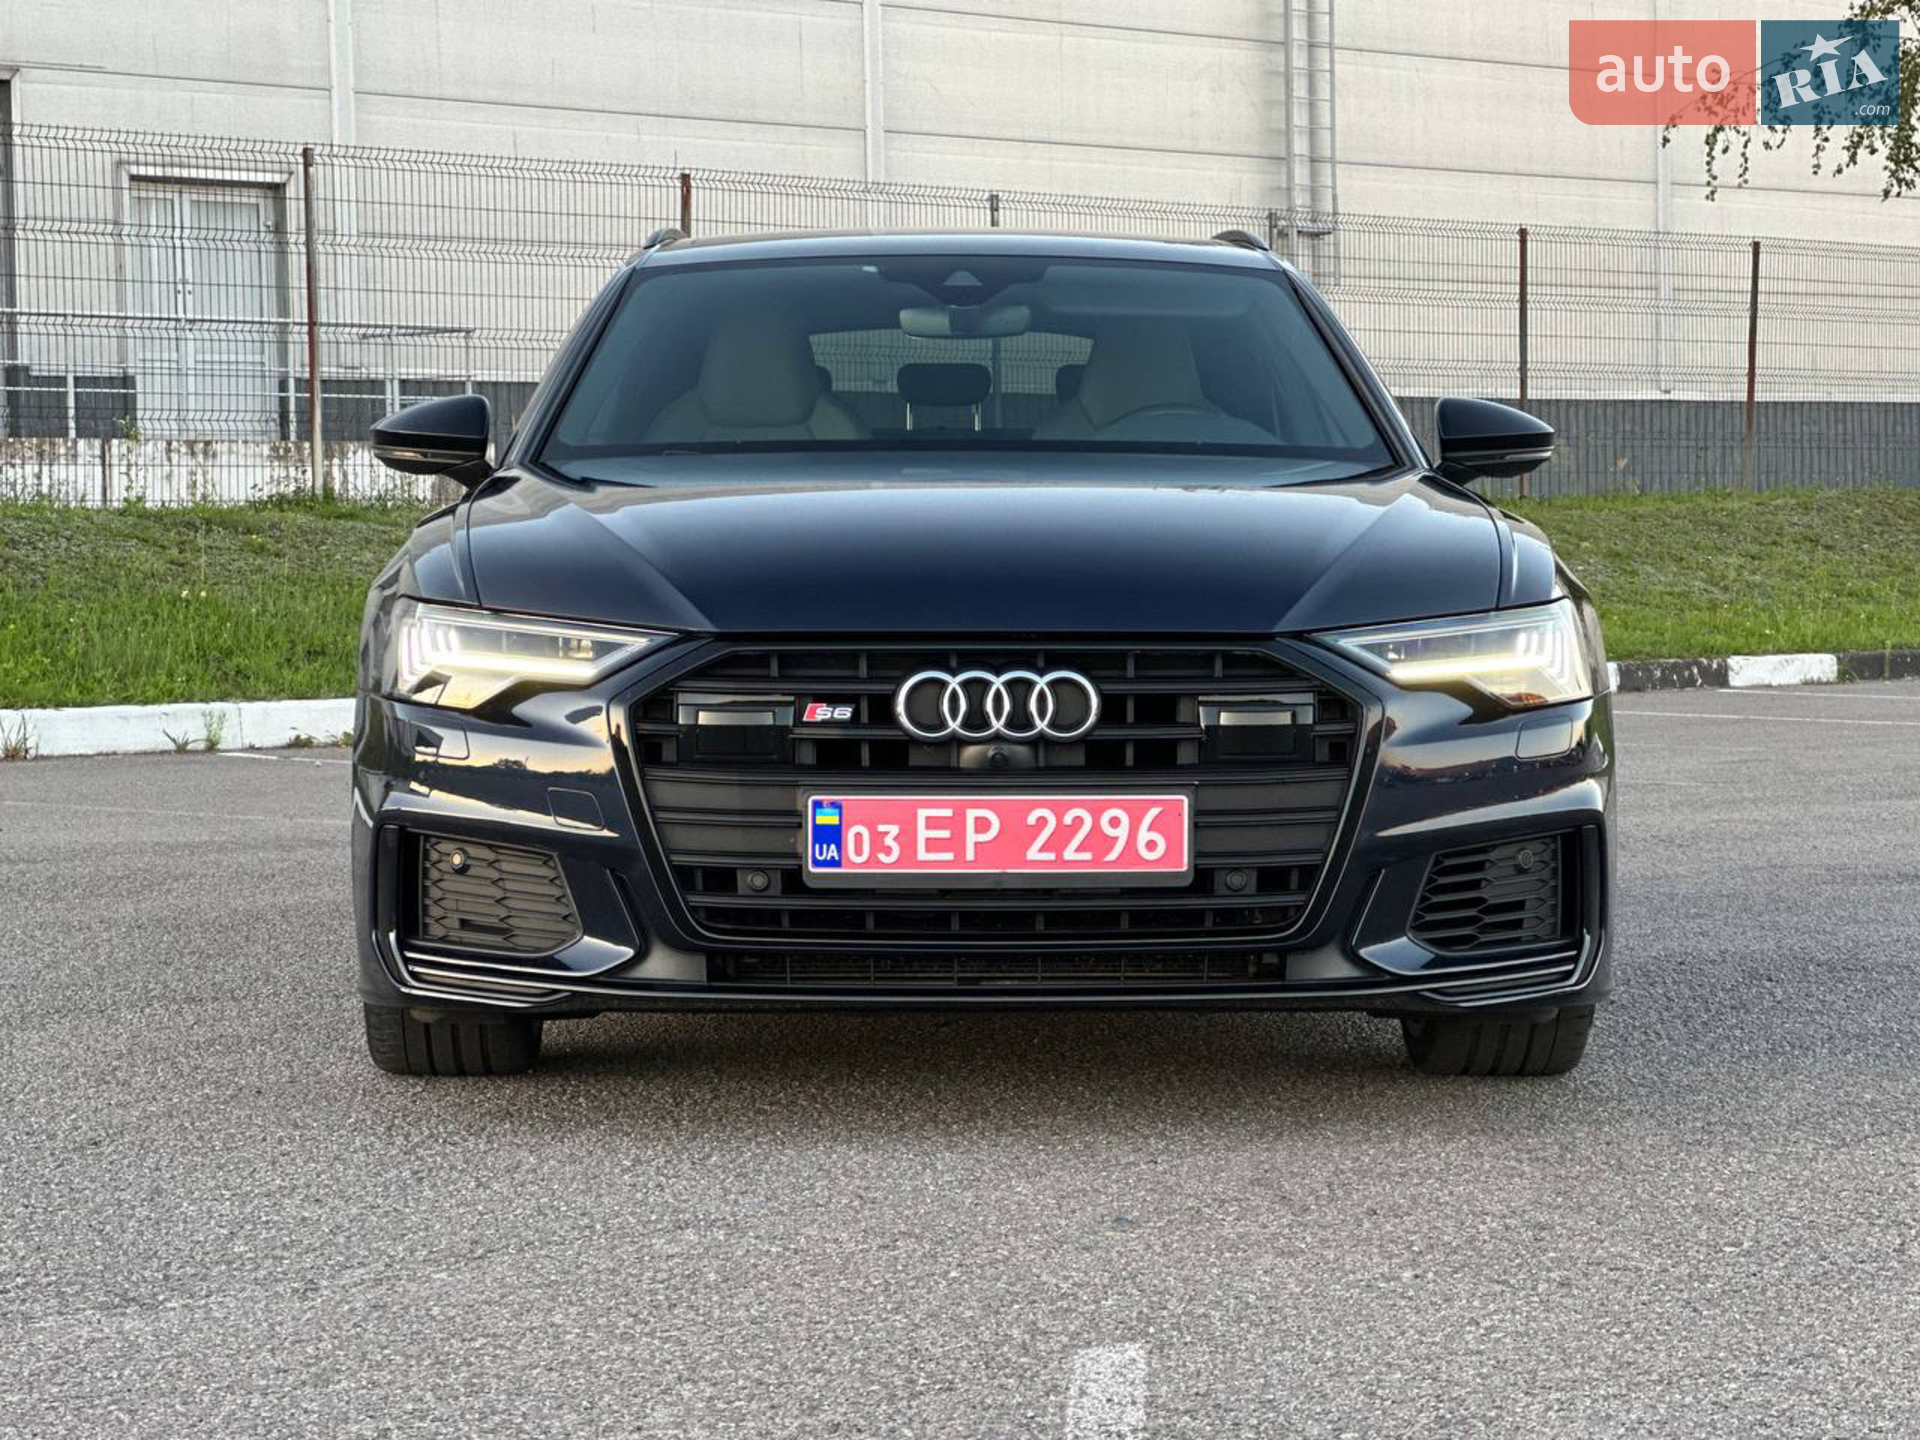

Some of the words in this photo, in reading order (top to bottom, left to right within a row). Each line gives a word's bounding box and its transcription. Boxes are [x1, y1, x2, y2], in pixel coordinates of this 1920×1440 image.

[815, 707, 853, 719] S6
[847, 824, 901, 865] 03
[916, 807, 1000, 862] EP
[1025, 807, 1167, 862] 2296
[815, 843, 839, 861] UA
